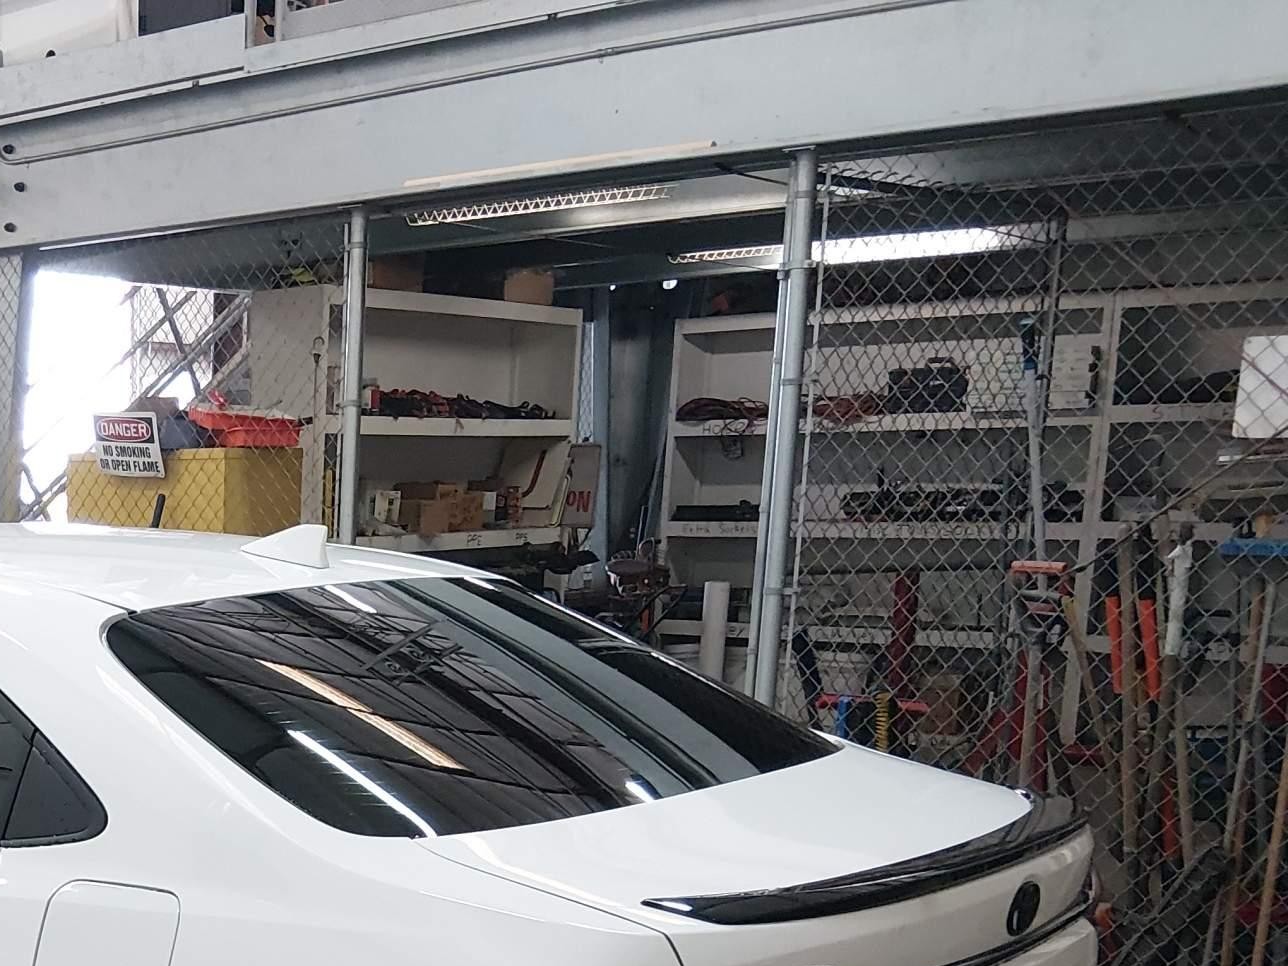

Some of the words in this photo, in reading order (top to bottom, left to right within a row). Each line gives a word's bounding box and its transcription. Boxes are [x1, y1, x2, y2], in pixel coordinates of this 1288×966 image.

[101, 423, 147, 437] DANGER
[103, 445, 113, 457] NO
[115, 446, 151, 458] SMOKING
[100, 459, 110, 470] OR
[112, 460, 131, 472] OPEN
[133, 461, 160, 473] FLAME
